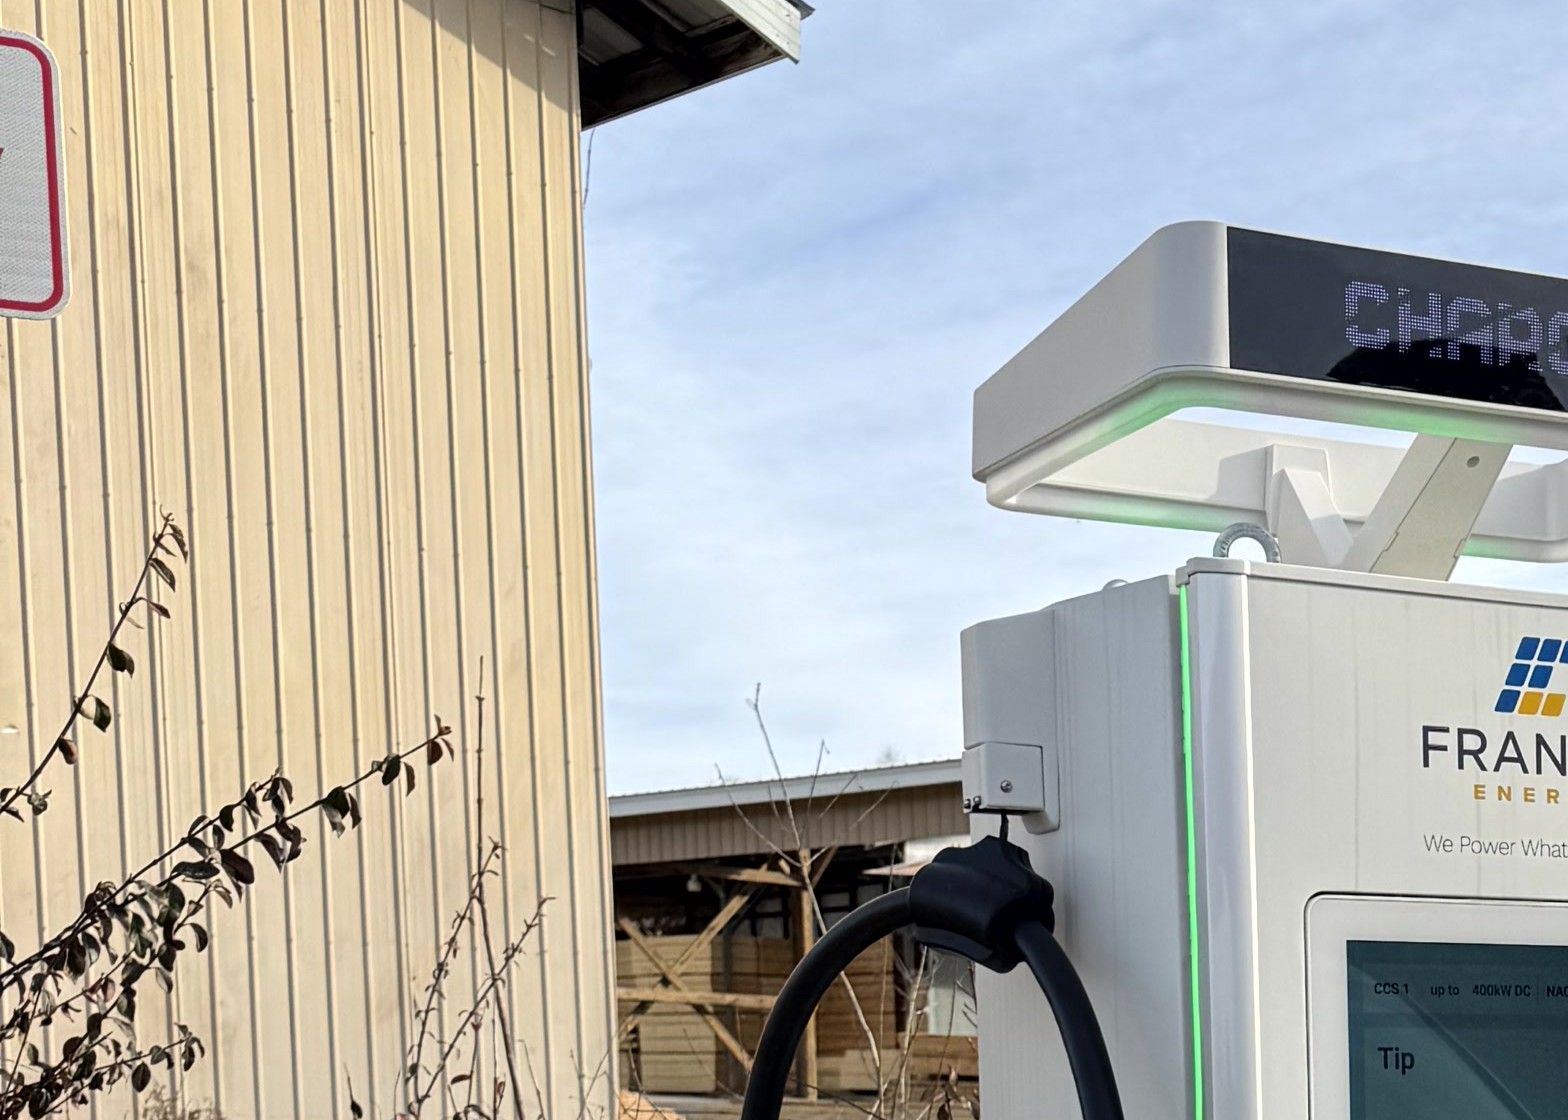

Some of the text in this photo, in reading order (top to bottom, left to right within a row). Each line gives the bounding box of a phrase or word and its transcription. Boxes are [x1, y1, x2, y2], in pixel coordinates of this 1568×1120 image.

[1424, 834, 1454, 852] We
[1460, 836, 1515, 856] Power
[1521, 839, 1568, 859] What
[1374, 982, 1409, 996] CCS 1
[1430, 983, 1531, 997] up to 400kW DC
[1377, 1047, 1415, 1075] Tip
